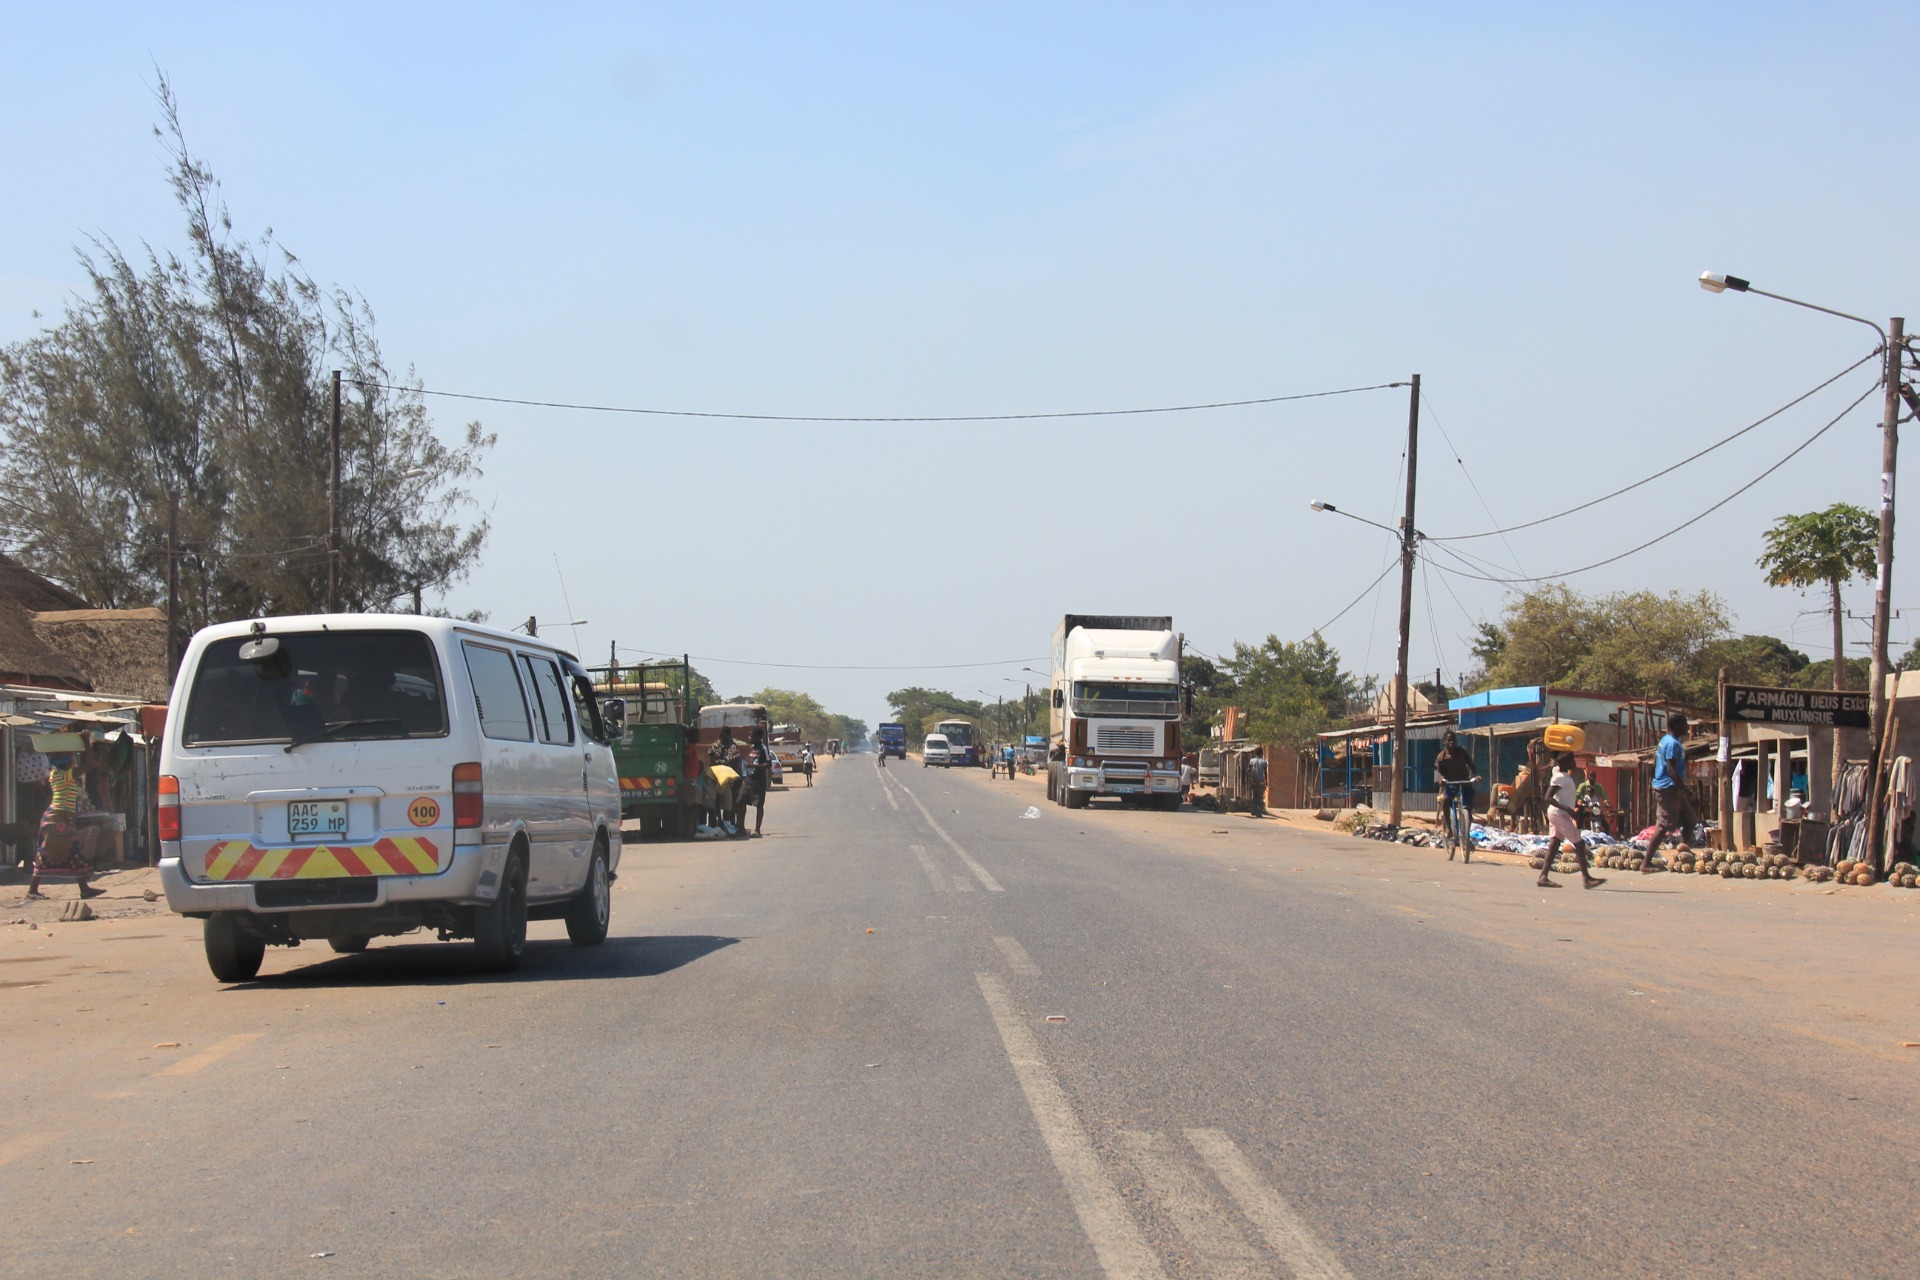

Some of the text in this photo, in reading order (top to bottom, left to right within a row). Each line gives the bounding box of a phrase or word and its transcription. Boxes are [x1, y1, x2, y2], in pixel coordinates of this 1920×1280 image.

[1811, 694, 1839, 709] DEUS
[1842, 696, 1870, 711] EXIST
[292, 804, 318, 817] AAC
[412, 806, 436, 818] 100
[292, 817, 345, 831] 259 MP
